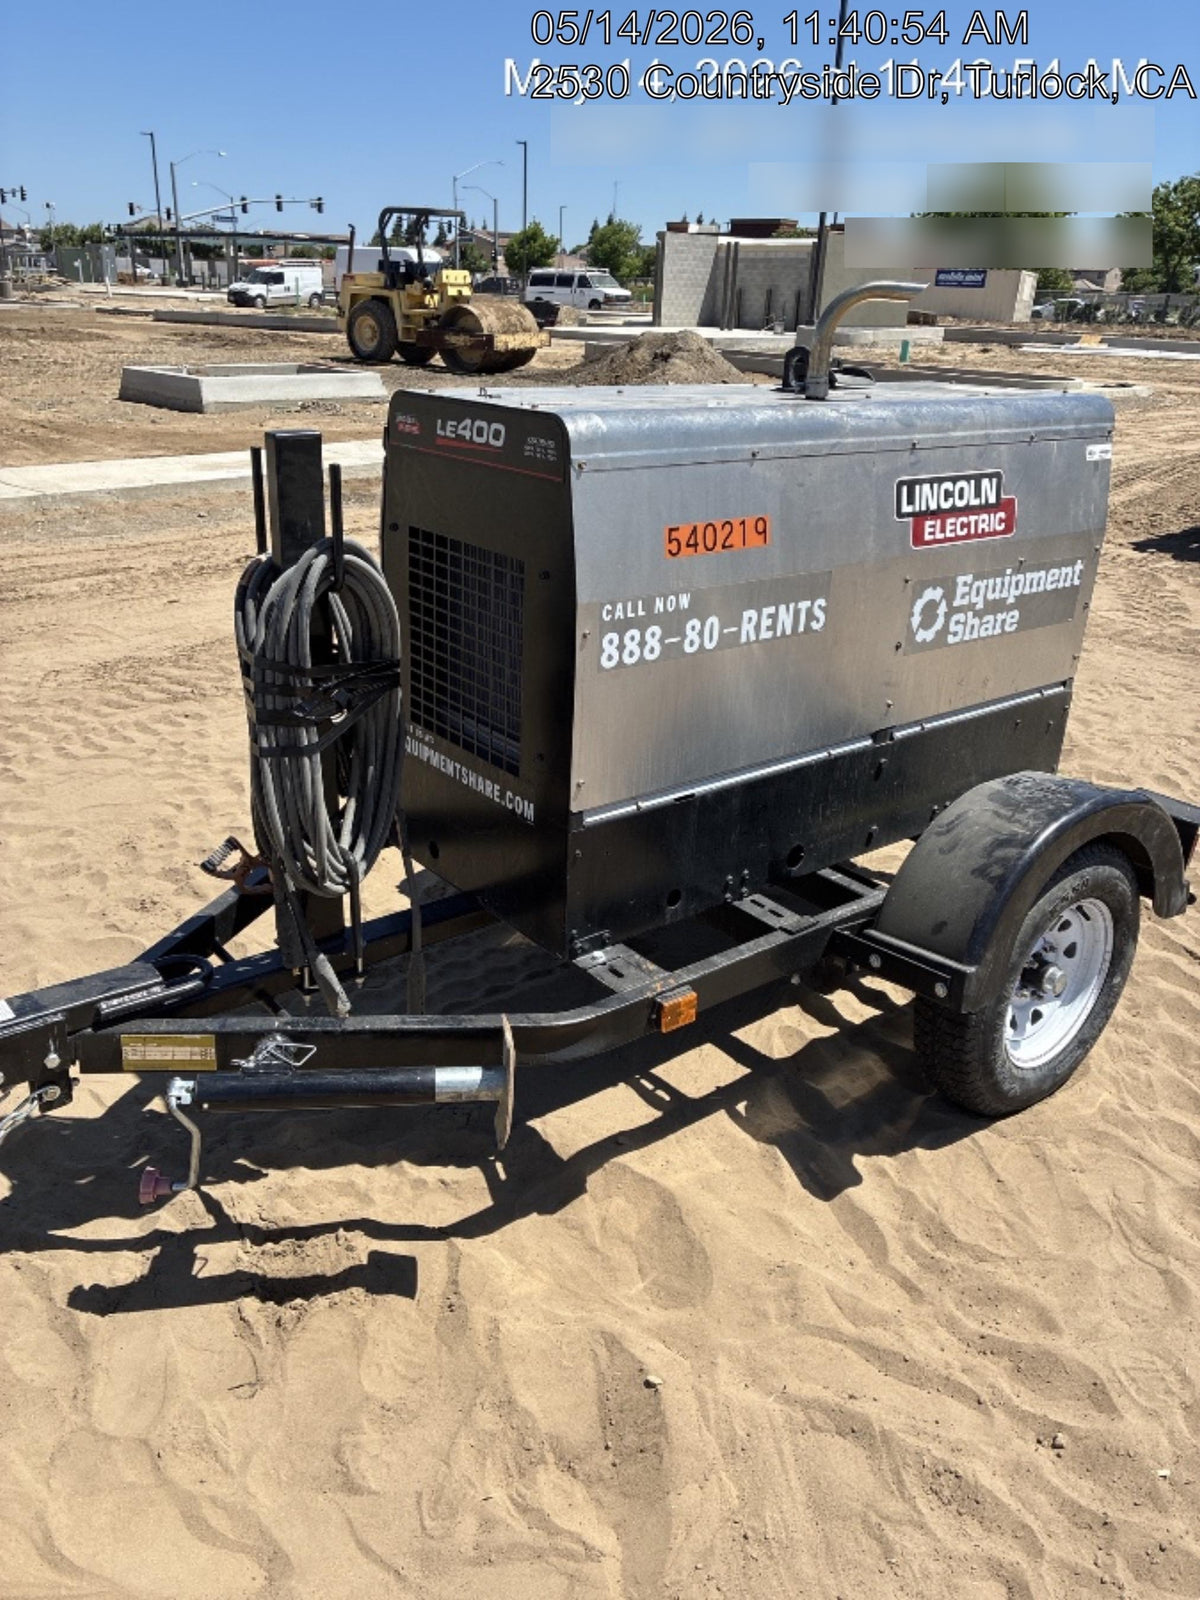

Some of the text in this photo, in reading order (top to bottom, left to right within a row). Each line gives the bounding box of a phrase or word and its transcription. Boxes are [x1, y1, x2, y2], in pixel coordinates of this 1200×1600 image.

[436, 418, 506, 448] LE400
[901, 477, 998, 513] LINCOLN
[667, 516, 768, 557] 540219
[924, 511, 1006, 541] ELECTRIC
[952, 559, 1085, 610] Equipment
[602, 592, 691, 622] CALL NOW
[600, 597, 828, 669] 888-80-RENTS
[947, 608, 1020, 644] Share
[405, 735, 535, 822] QUIPMENTSHARE.COM
